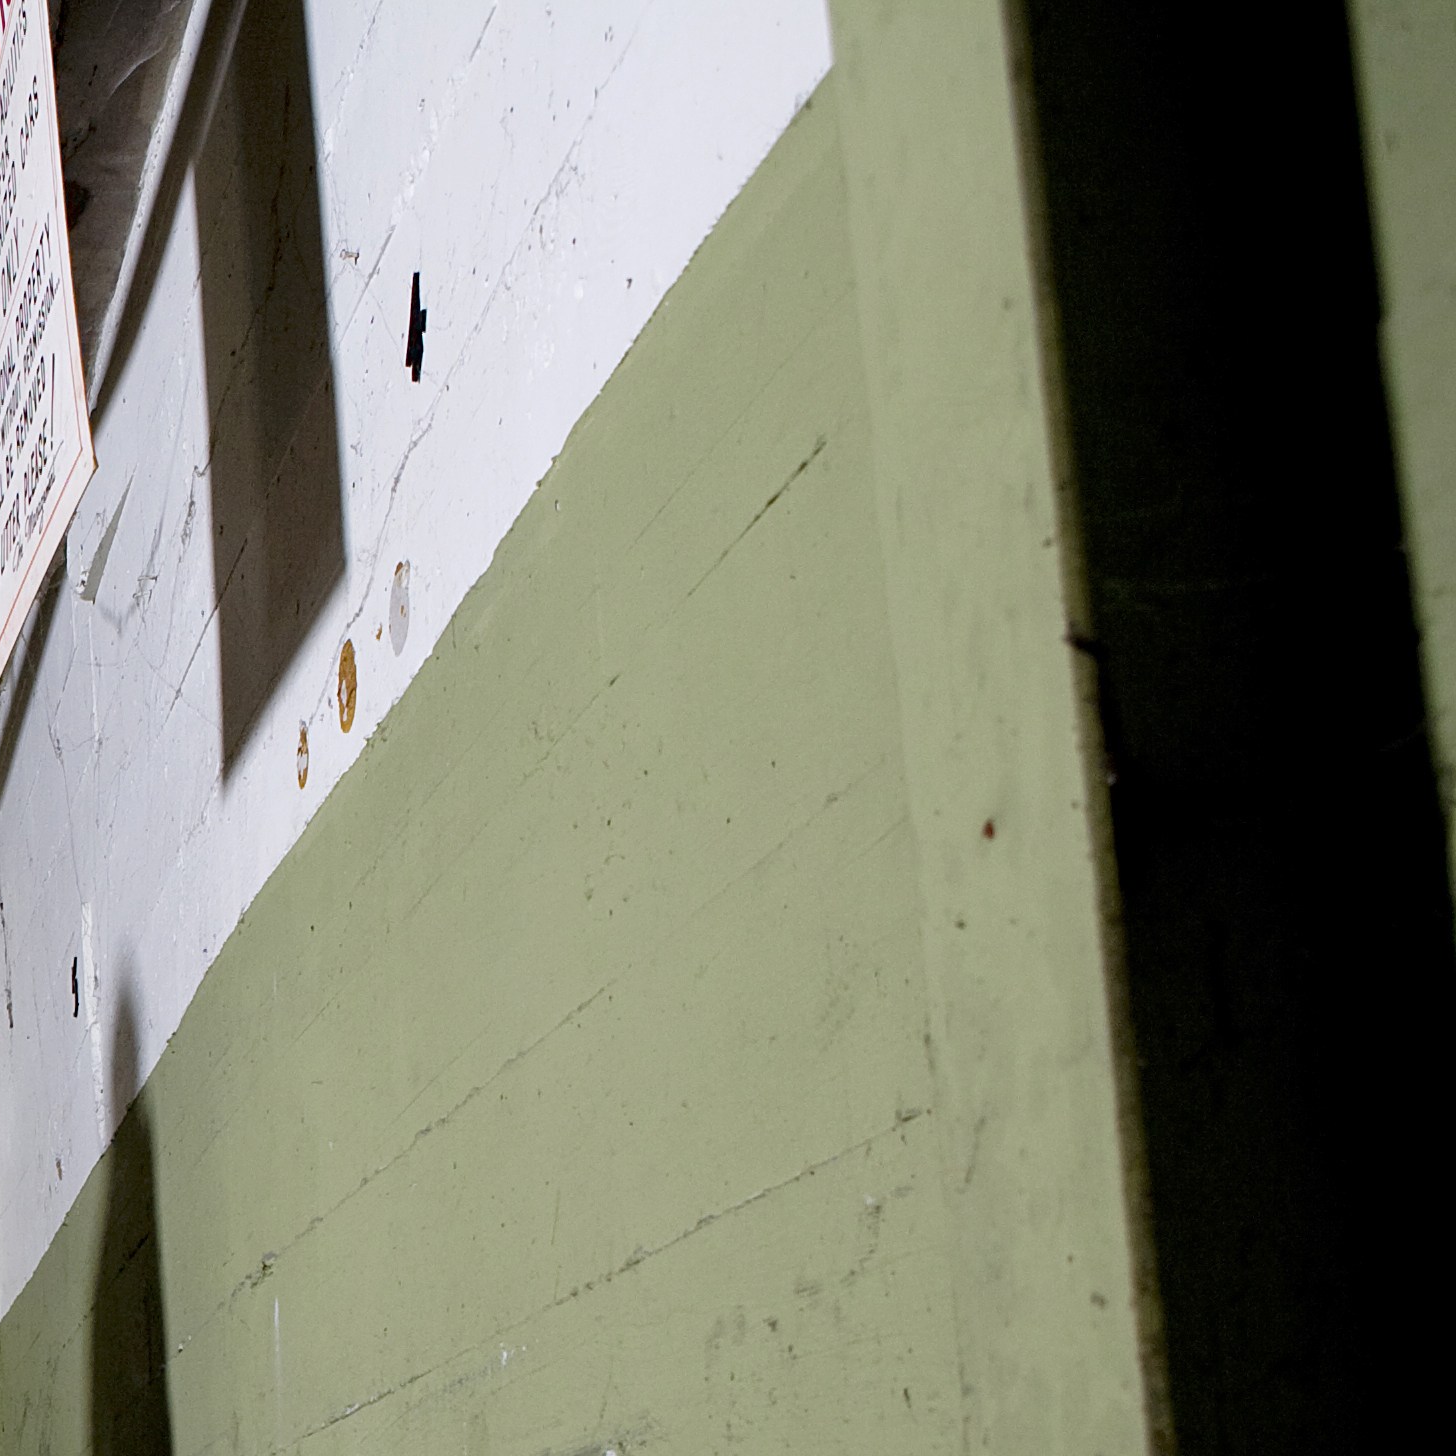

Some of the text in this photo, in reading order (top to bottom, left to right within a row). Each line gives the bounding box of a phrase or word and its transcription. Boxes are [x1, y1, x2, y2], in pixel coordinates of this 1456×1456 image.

[18, 75, 39, 170] CARS
[0, 216, 20, 317] ONLY
[15, 212, 51, 357] PROPERTY
[5, 443, 14, 489] BE
[14, 354, 46, 460] REMOVED
[0, 491, 21, 576] LITTER
